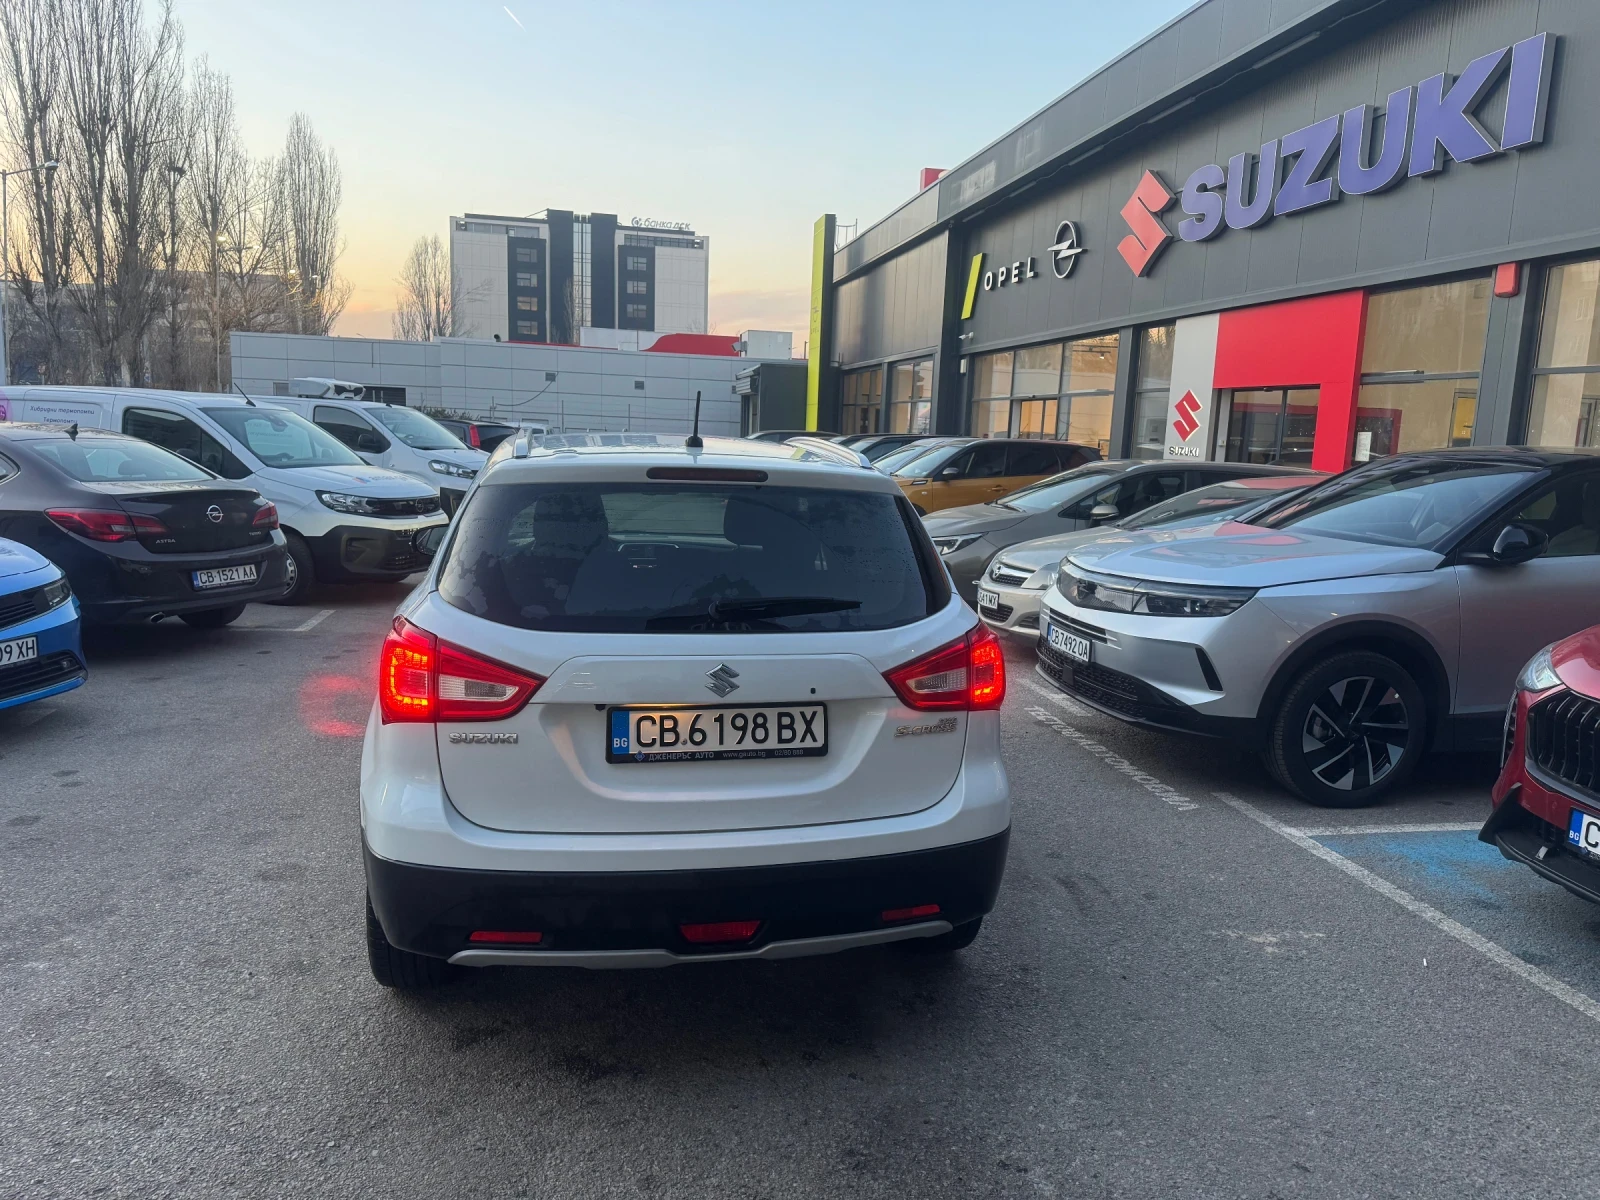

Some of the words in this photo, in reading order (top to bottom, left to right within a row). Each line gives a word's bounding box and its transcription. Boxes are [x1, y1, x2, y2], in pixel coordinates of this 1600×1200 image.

[1178, 32, 1552, 243] SUZUKI
[644, 217, 672, 229] банка
[984, 256, 1036, 291] OPEL
[1169, 446, 1199, 457] SUZUKI
[16, 639, 35, 660] XH
[449, 732, 519, 744] SUZUKI
[613, 737, 628, 748] BG
[649, 752, 692, 761] ДЖЕНЕРЪС
[695, 751, 714, 759] АУТО
[1569, 830, 1580, 841] BG
